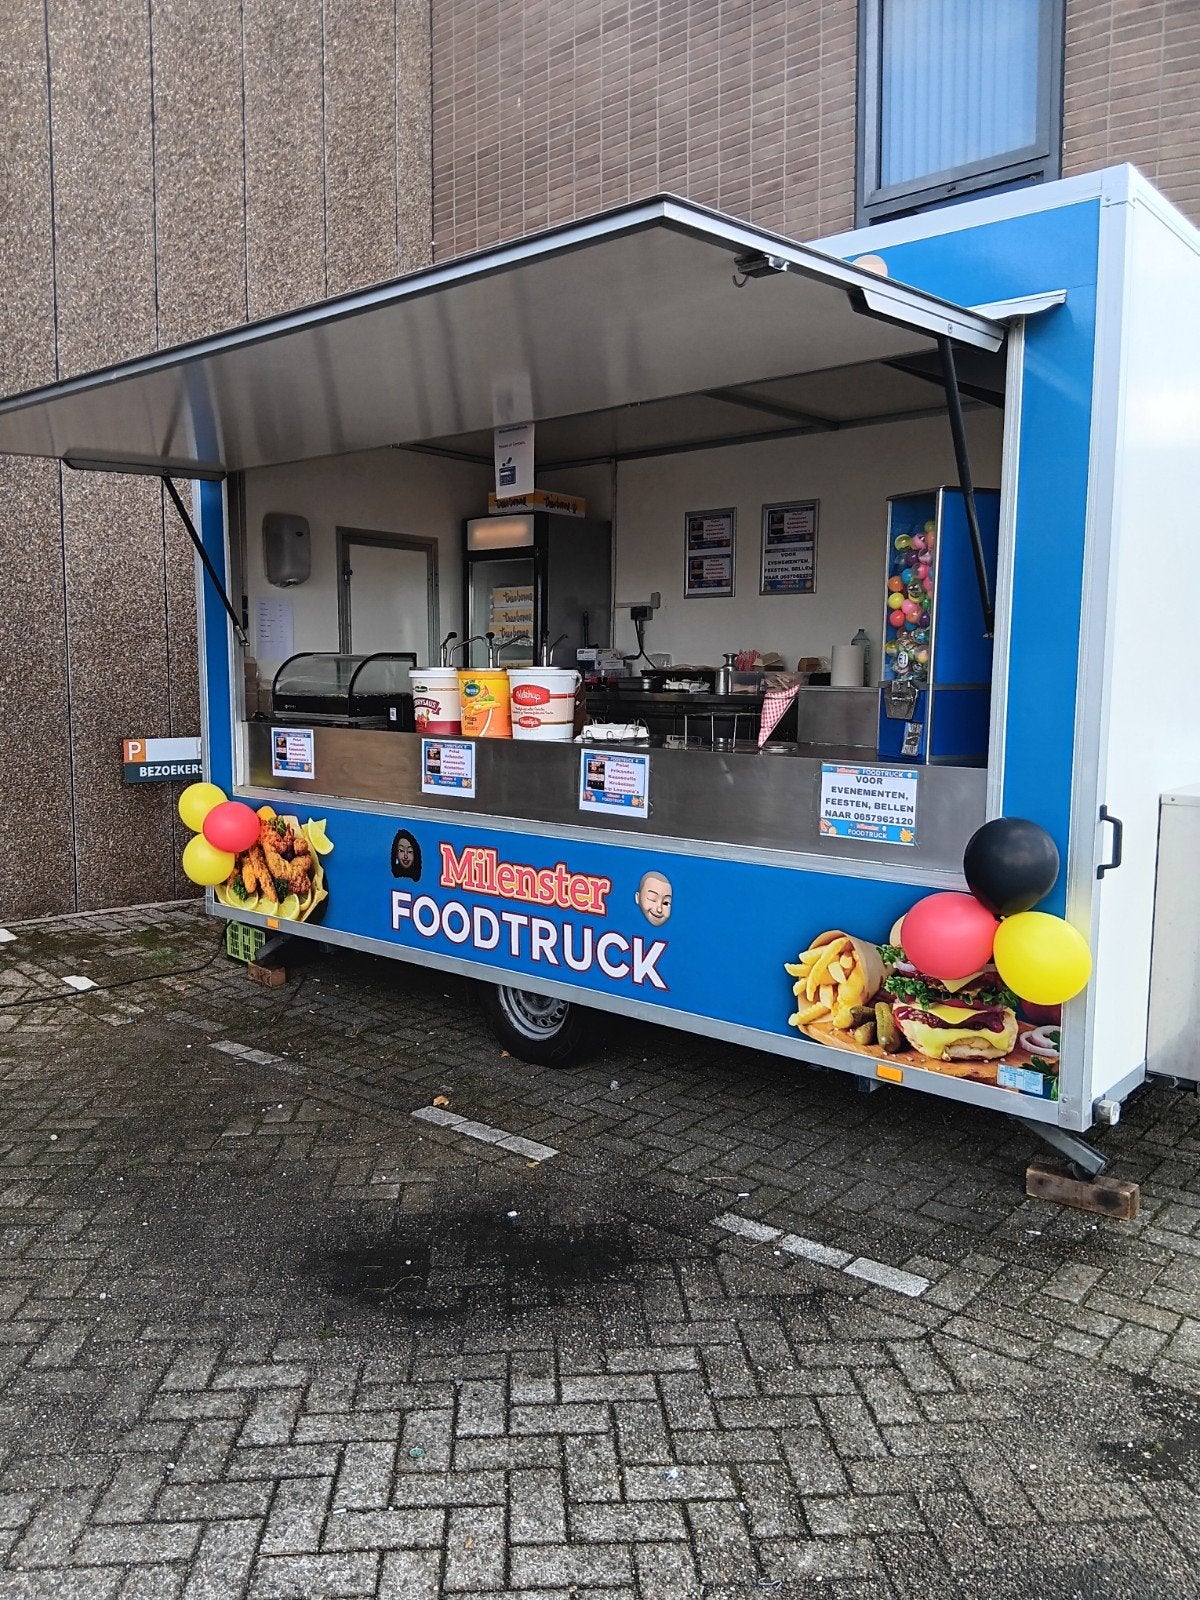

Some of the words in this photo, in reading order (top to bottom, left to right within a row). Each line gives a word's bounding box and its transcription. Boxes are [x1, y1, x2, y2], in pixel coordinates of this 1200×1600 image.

[128, 741, 142, 761] P
[139, 763, 203, 777] BEZOEKERS
[862, 769, 904, 778] FOODTRUCK
[855, 776, 883, 785] VOOR
[831, 786, 909, 800] EVENEMENTEN,
[825, 797, 872, 810] FEESTEN,
[874, 802, 914, 813] BELLEN
[825, 809, 851, 819] NAAR
[853, 812, 914, 826] 0657962120
[847, 828, 888, 839] FOODTRUCK
[440, 842, 611, 916] Milenster
[391, 890, 670, 991] FOODTRUCK
